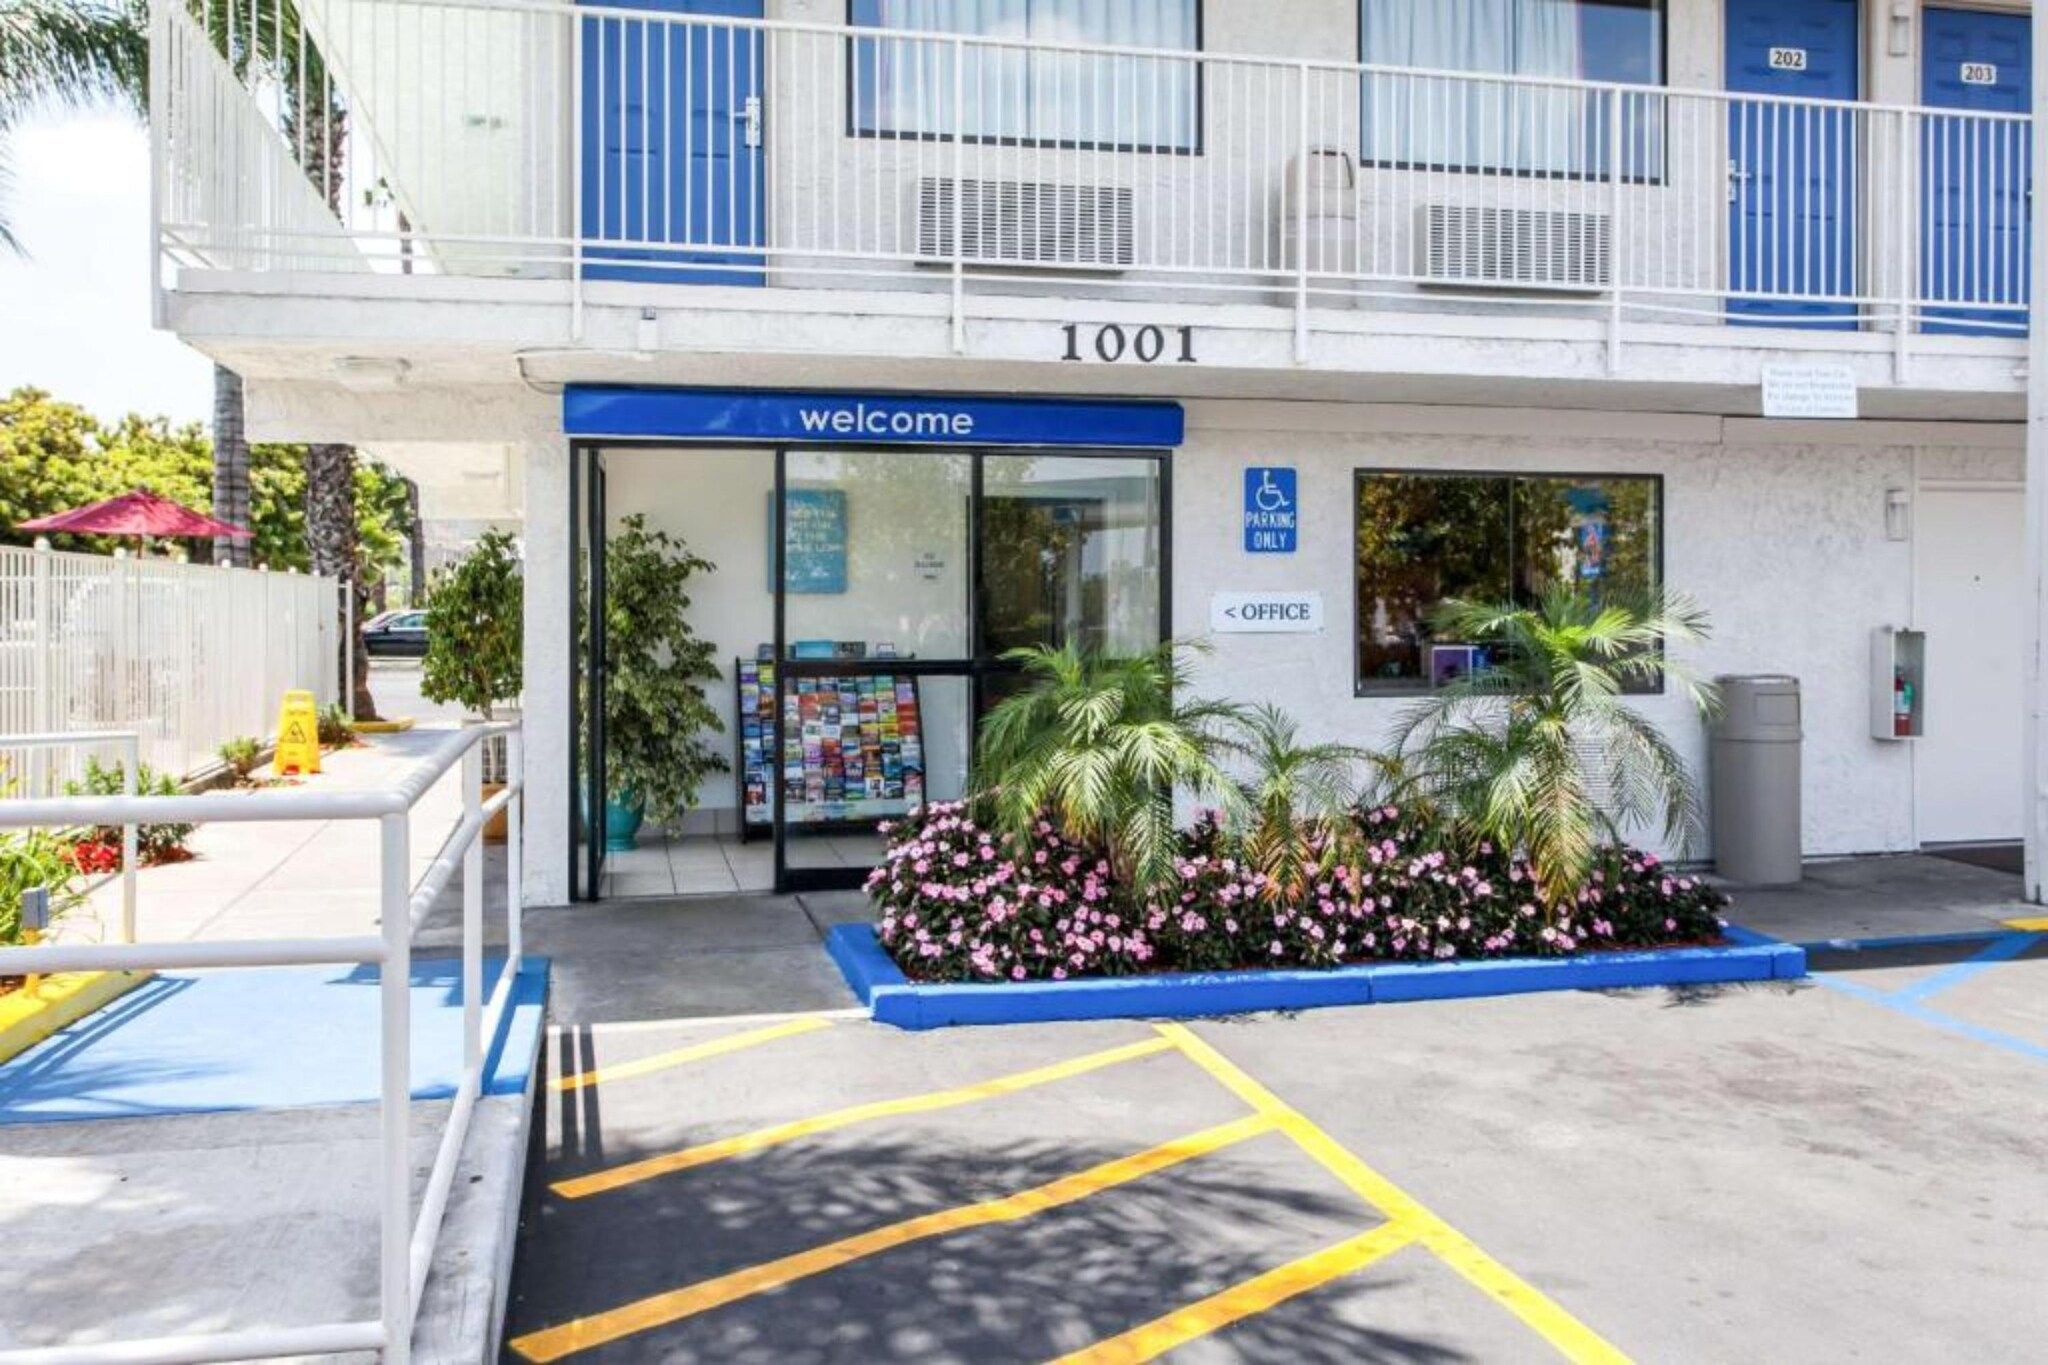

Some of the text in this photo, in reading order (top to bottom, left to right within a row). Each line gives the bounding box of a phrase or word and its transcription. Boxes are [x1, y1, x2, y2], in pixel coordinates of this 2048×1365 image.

[1773, 50, 1803, 67] 202
[1965, 65, 1993, 82] 203
[1061, 323, 1197, 363] 1001
[800, 403, 974, 435] welcome
[1245, 511, 1295, 529] PARKING
[1253, 531, 1287, 550] ONLY
[1241, 603, 1311, 621] OFFICE
